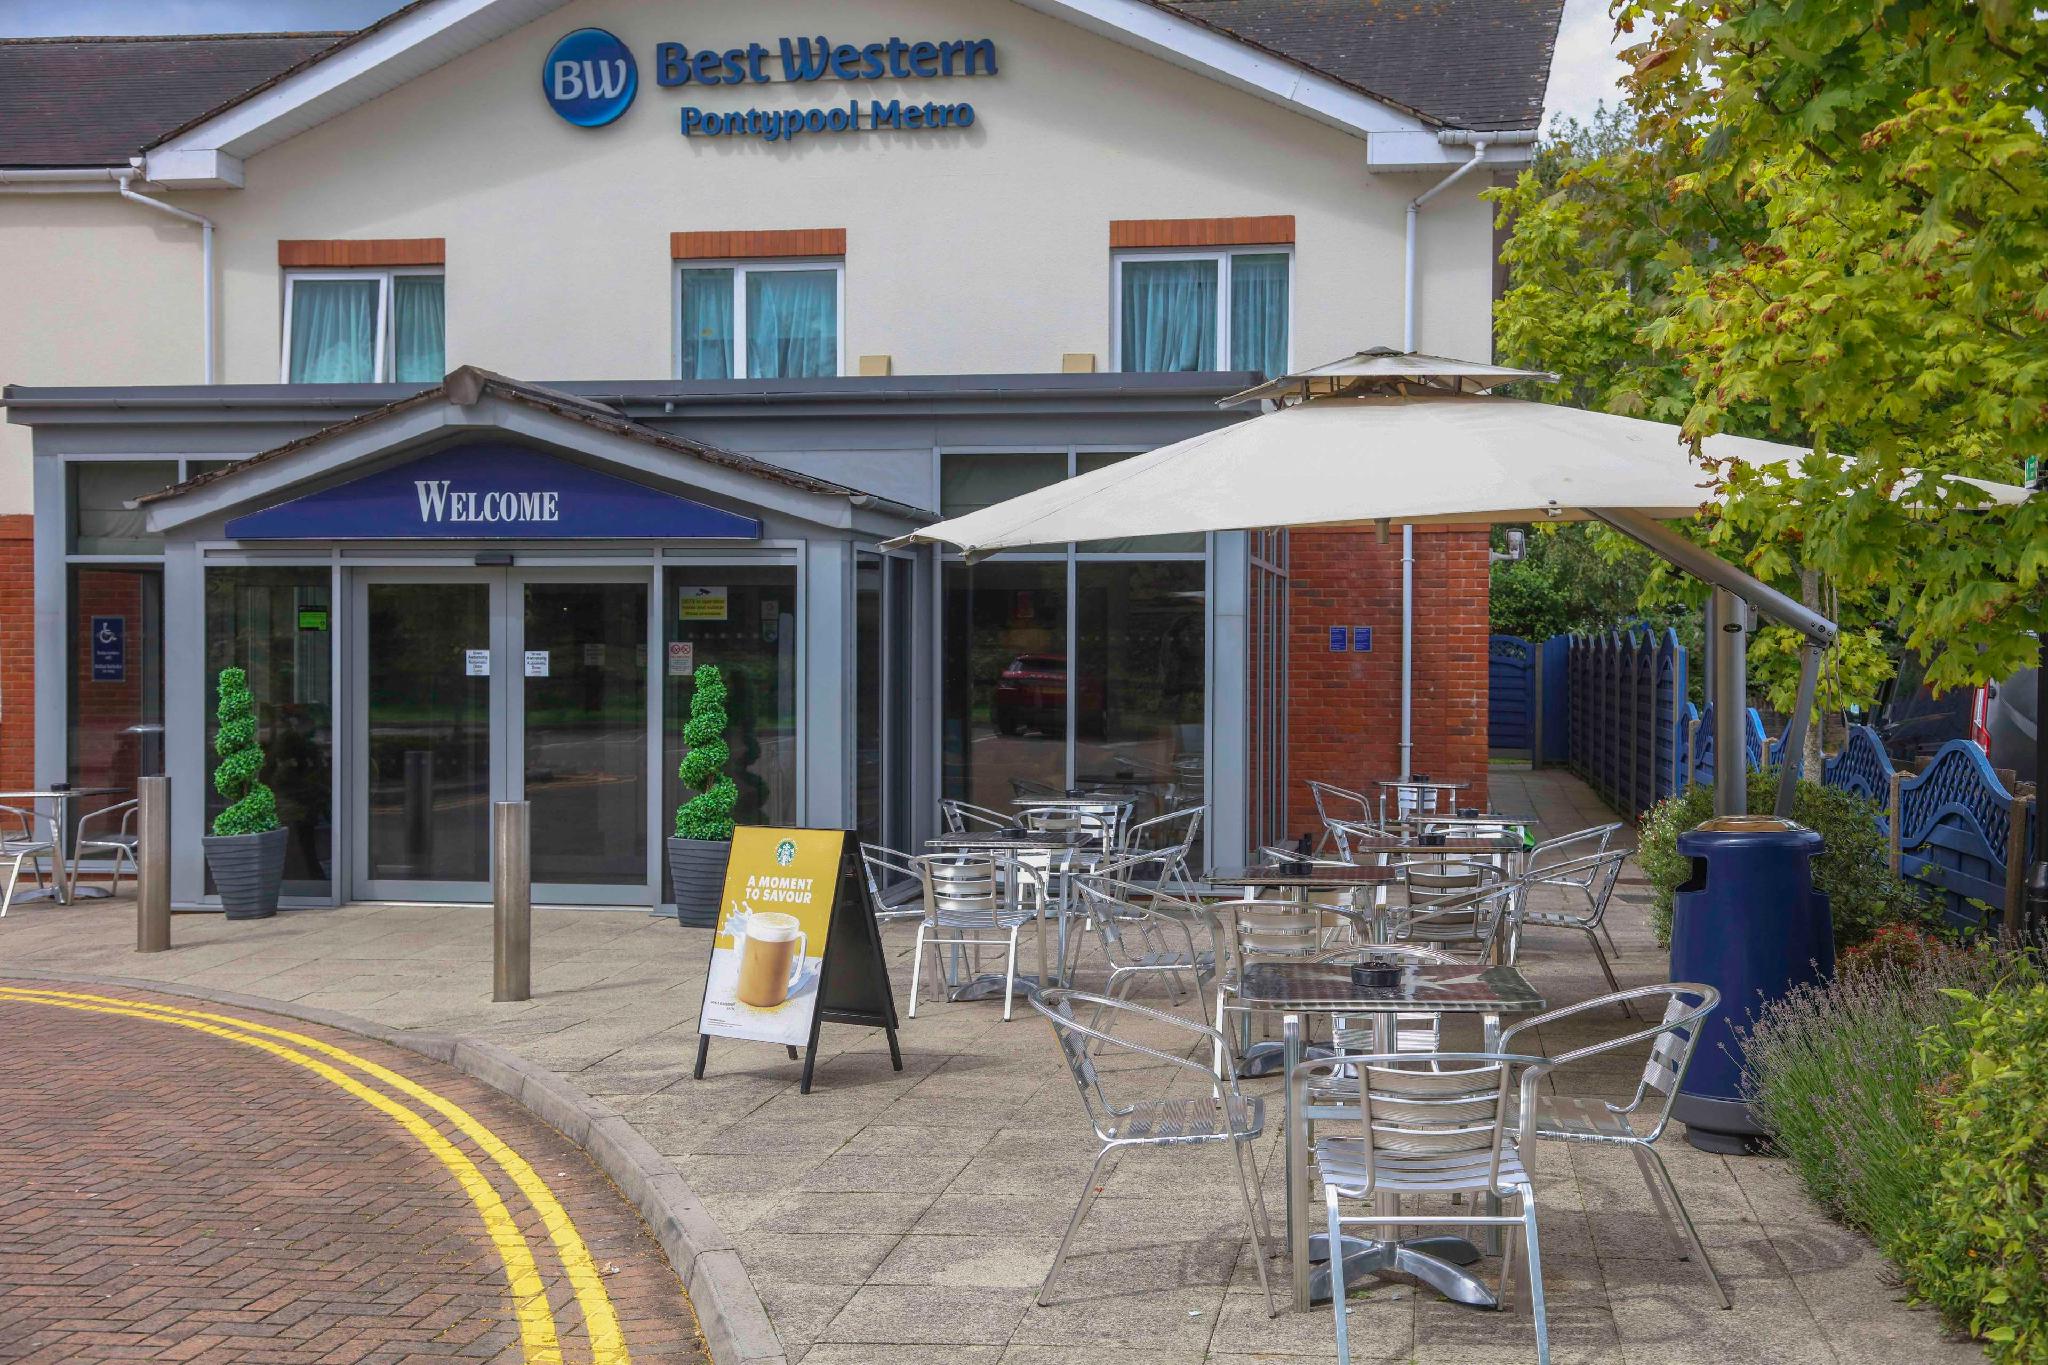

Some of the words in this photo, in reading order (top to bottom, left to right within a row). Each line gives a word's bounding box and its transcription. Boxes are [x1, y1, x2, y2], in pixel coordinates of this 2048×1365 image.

[554, 59, 627, 101] BW
[656, 42, 770, 87] Best
[779, 36, 998, 81] Western
[681, 100, 858, 141] Pontypool
[871, 99, 975, 130] Metro
[414, 480, 559, 522] WELCOME
[745, 887, 760, 900] TO
[763, 889, 812, 904] SAVOUR
[747, 875, 756, 887] A
[758, 876, 813, 890] MOMENT
